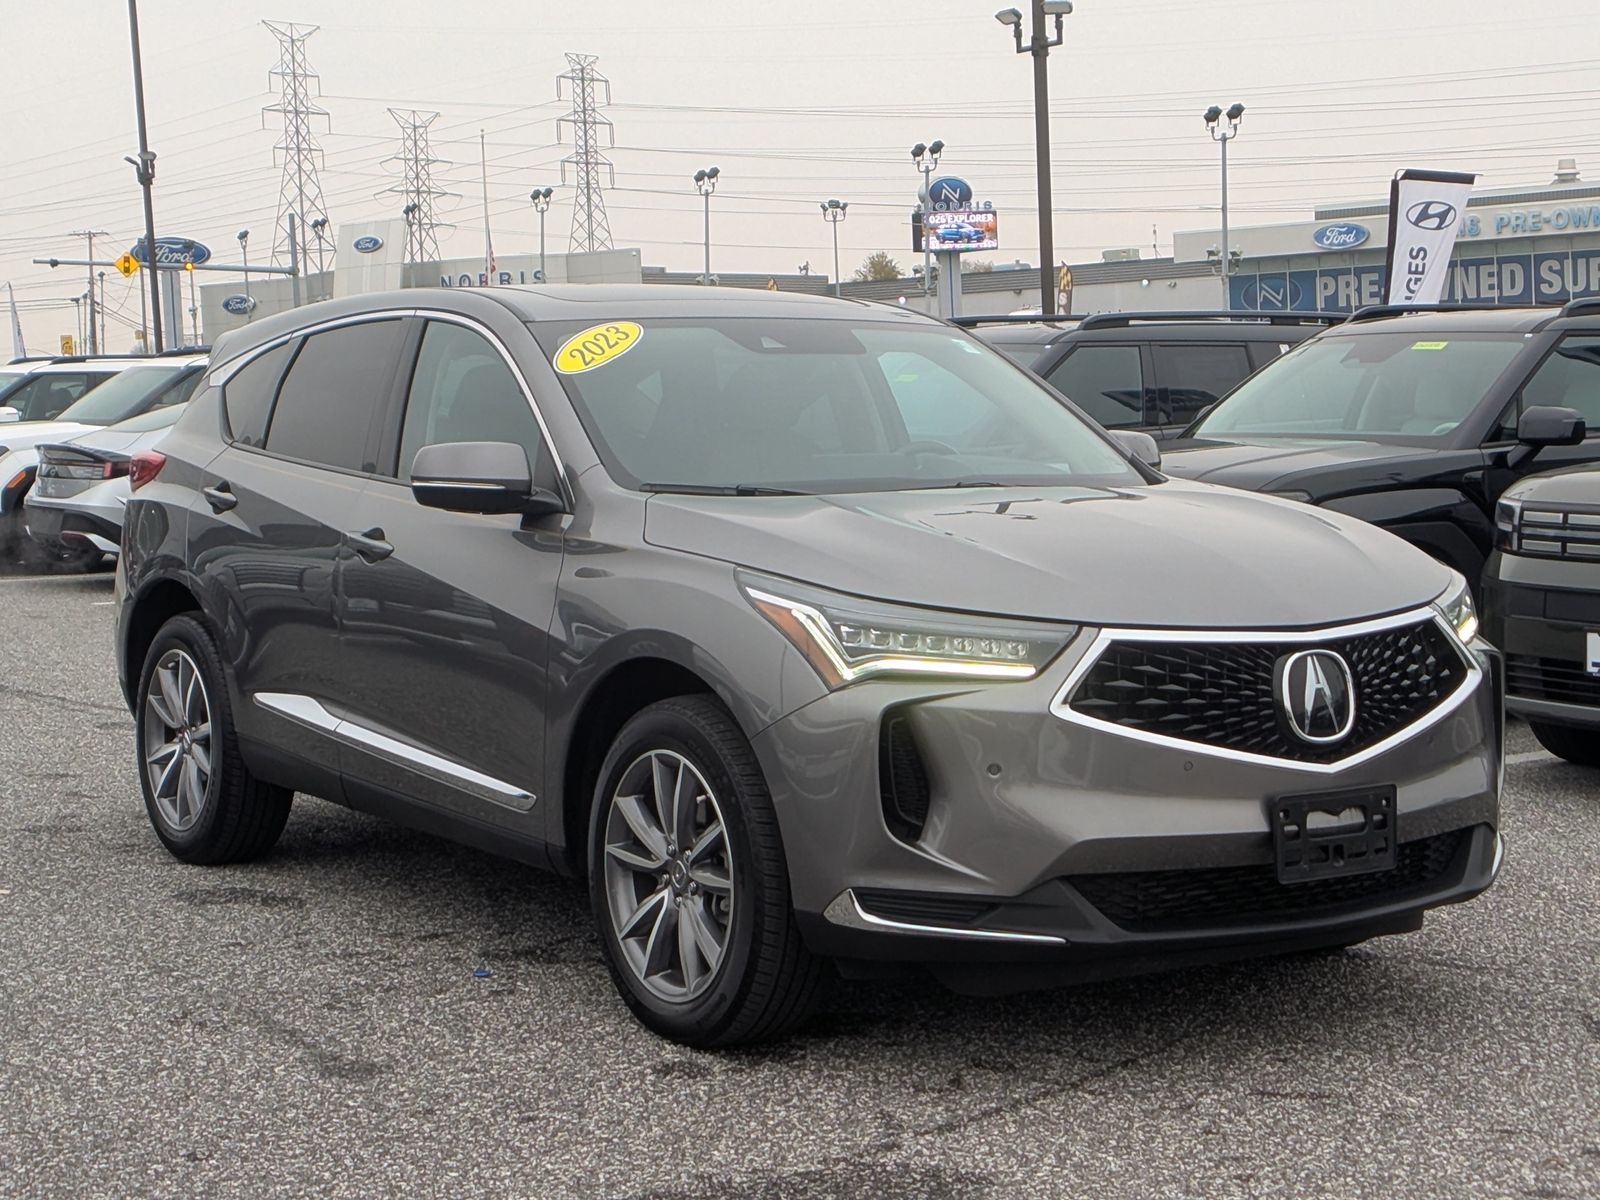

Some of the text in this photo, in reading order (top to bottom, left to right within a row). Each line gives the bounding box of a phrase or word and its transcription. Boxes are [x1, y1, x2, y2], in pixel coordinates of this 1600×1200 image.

[923, 213, 994, 224] 026 EXPLORER
[1323, 226, 1357, 245] Ford
[440, 270, 547, 288] NORRIS
[569, 325, 630, 367] 2023
